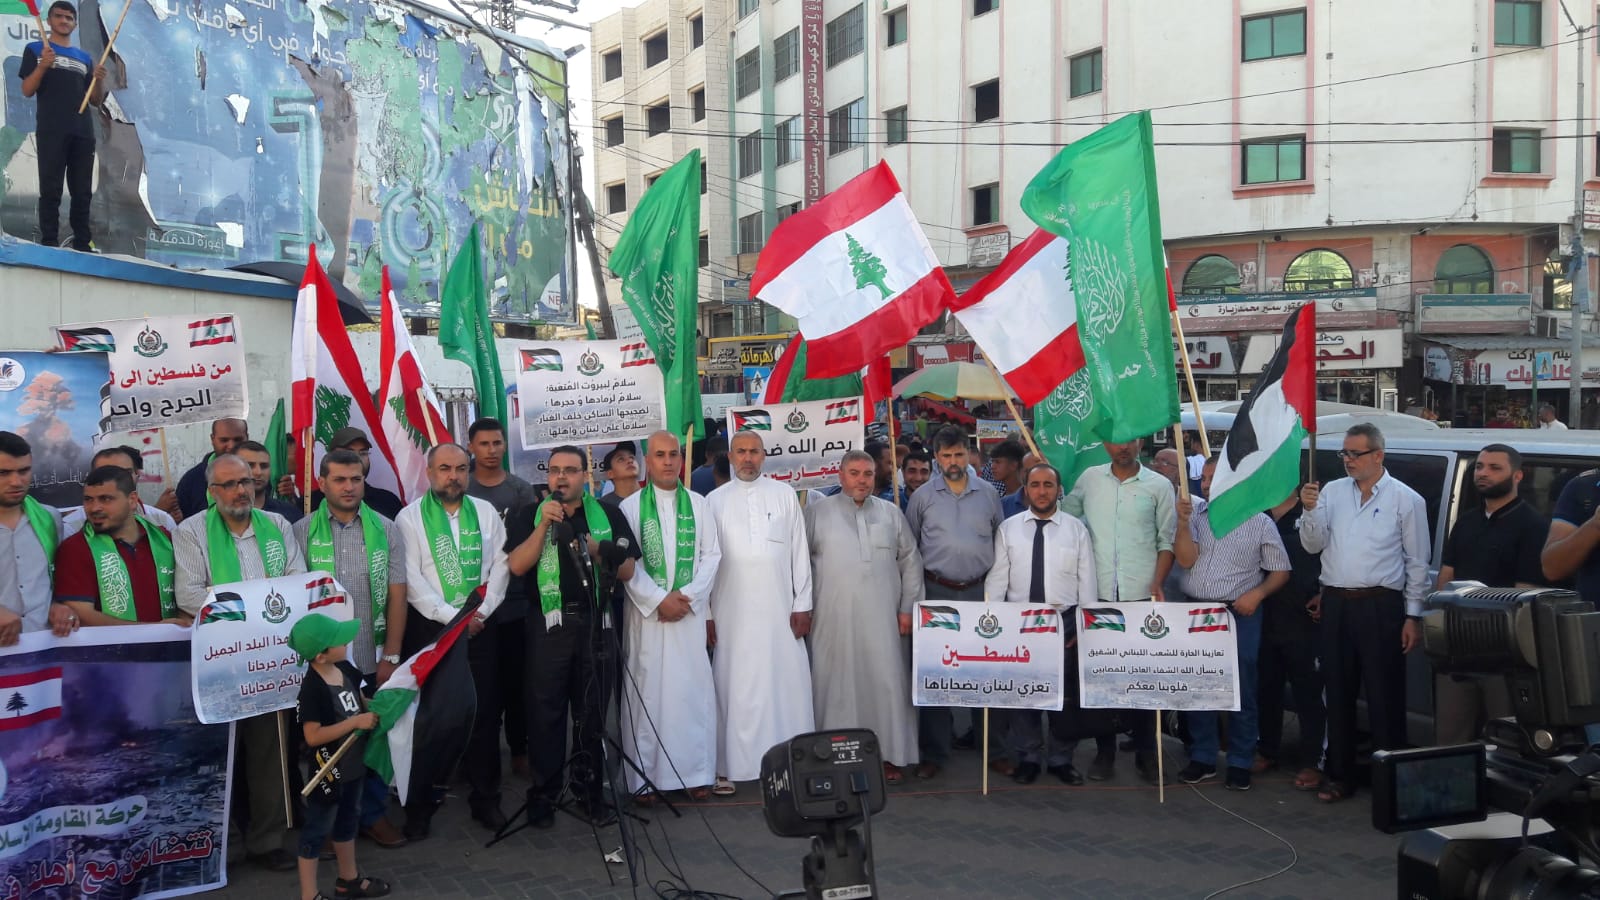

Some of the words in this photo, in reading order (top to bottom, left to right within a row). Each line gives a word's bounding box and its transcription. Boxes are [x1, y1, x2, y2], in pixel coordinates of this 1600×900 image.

[242, 18, 264, 50] أي
[268, 32, 299, 57] في
[741, 344, 774, 366] كهرمانة
[1508, 348, 1536, 361] اركت
[147, 363, 206, 386] فلسطين
[210, 363, 231, 379] من
[160, 388, 211, 417] الجرح
[562, 412, 582, 421] خلف
[584, 408, 614, 420] الساكن
[579, 424, 599, 436] لبنان
[601, 424, 619, 433] على
[787, 437, 816, 454] الله
[821, 438, 852, 457] رحم
[204, 640, 242, 661] الجميل
[245, 636, 270, 651] البلد
[942, 645, 1031, 667] فلسطين
[1088, 648, 1118, 658] الشقيق
[1119, 648, 1148, 658] اللبناني
[1149, 648, 1178, 657] للشعب
[1180, 648, 1200, 657] الحارة
[1128, 666, 1151, 675] العاجل
[1153, 665, 1179, 674] الشفاء
[1180, 666, 1194, 674] الله
[1195, 664, 1217, 676] نسأل
[924, 677, 979, 693] بضحاياها
[982, 679, 1013, 694] لبنان
[1017, 681, 1051, 698] تعزي
[1126, 681, 1155, 693] معكم
[1158, 681, 1188, 692] قلوبنا
[35, 809, 91, 834] المقاومة
[95, 803, 144, 826] حركة
[121, 830, 215, 886] تتضامن
[80, 860, 118, 895] مع
